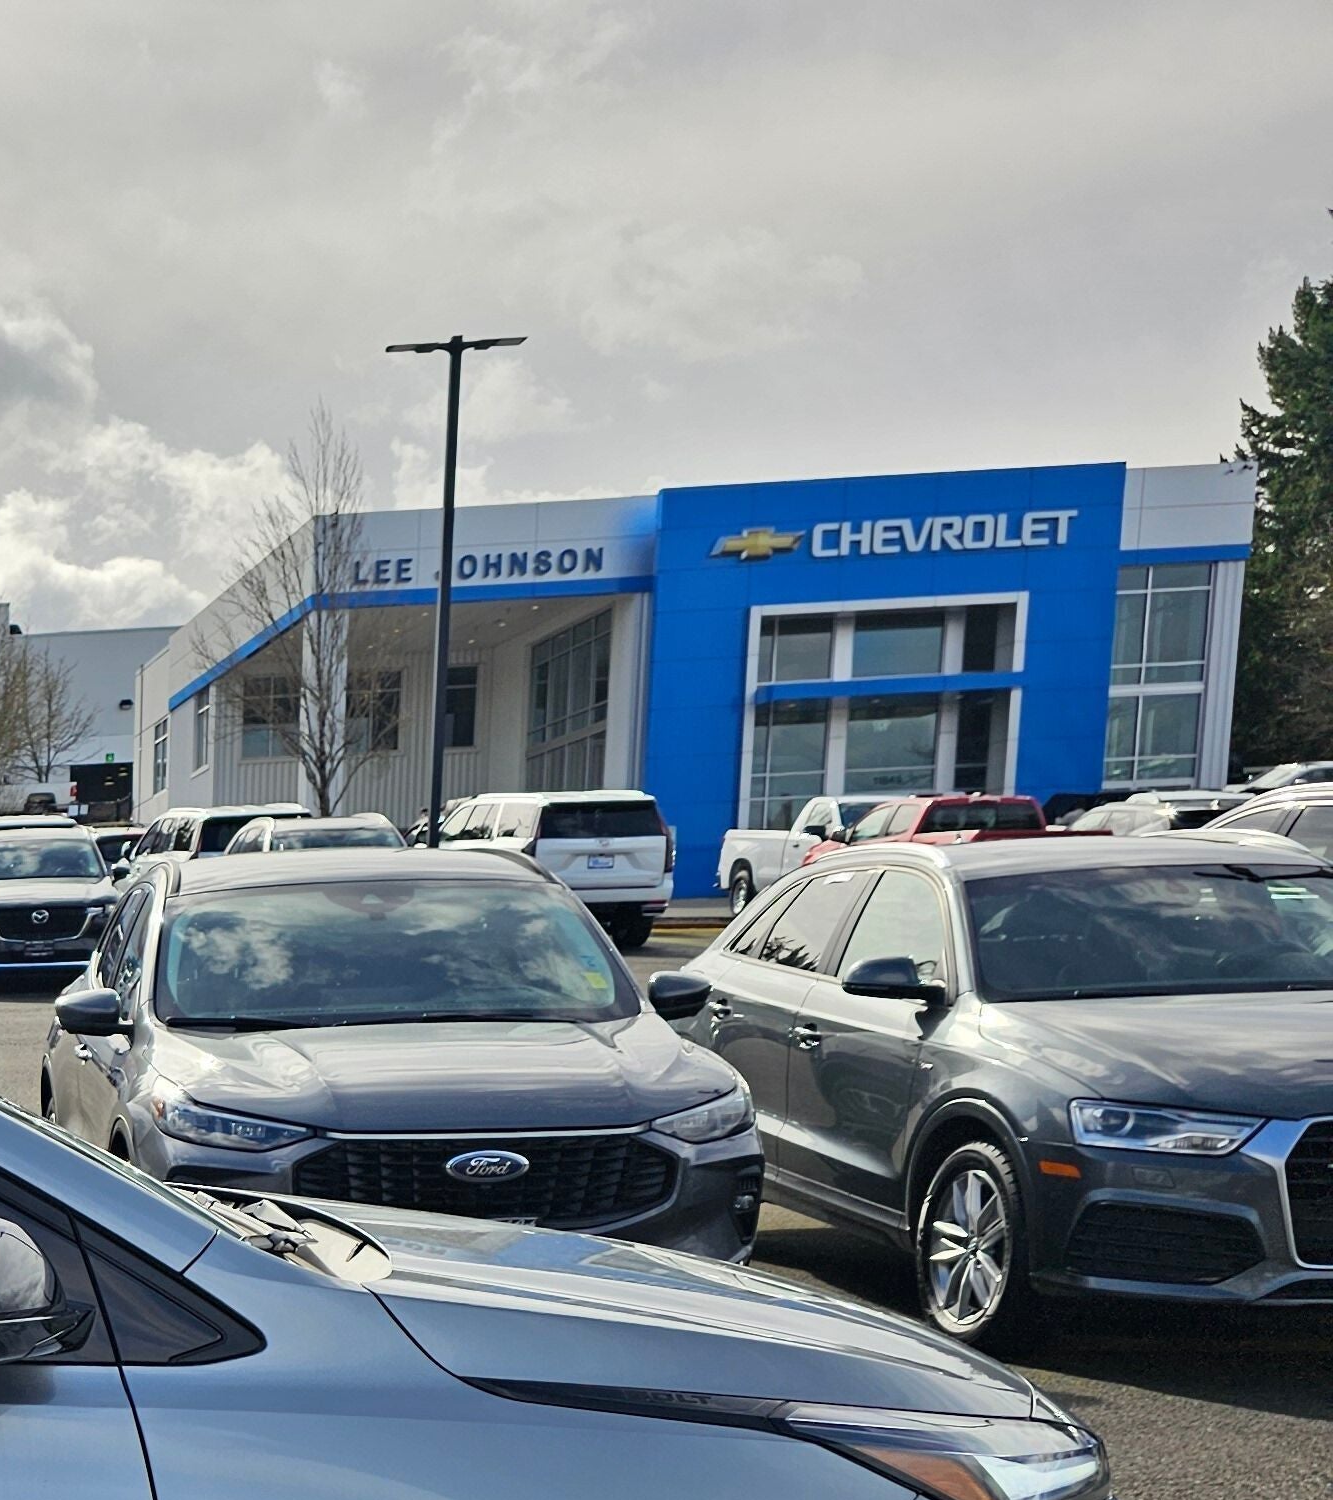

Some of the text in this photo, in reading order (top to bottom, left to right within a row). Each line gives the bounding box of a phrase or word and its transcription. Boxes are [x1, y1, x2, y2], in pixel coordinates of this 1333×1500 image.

[811, 509, 1079, 558] CHEVROLET
[353, 546, 605, 585] LEE OHNSON
[466, 1157, 512, 1175] Ford
